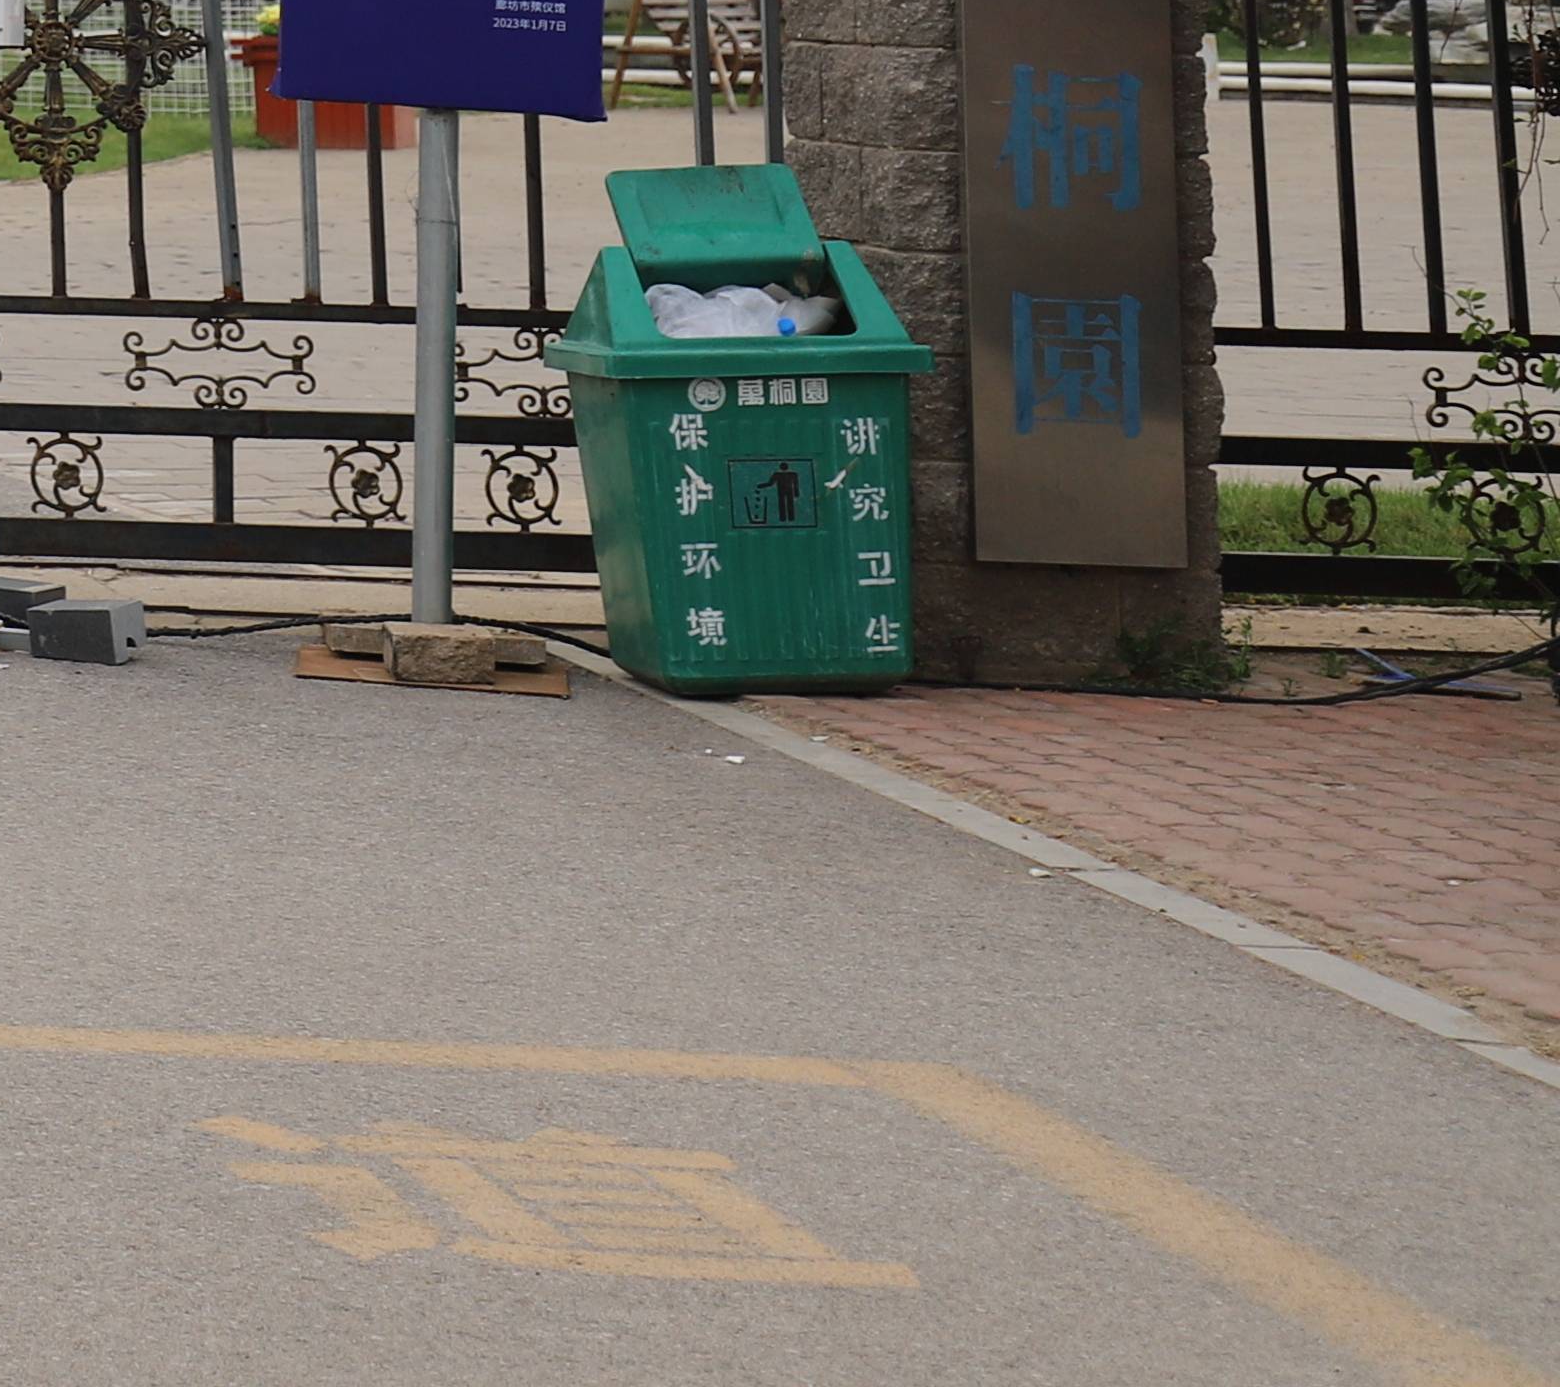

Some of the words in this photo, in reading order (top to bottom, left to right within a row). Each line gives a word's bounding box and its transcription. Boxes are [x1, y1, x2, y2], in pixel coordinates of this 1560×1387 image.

[495, 0, 566, 14] 廊坊市殡仪馆
[493, 17, 566, 32] 2023年1月7日
[737, 377, 829, 407] 萬桐園
[668, 413, 728, 646] 保护环境
[840, 417, 901, 653] 讲究卫生
